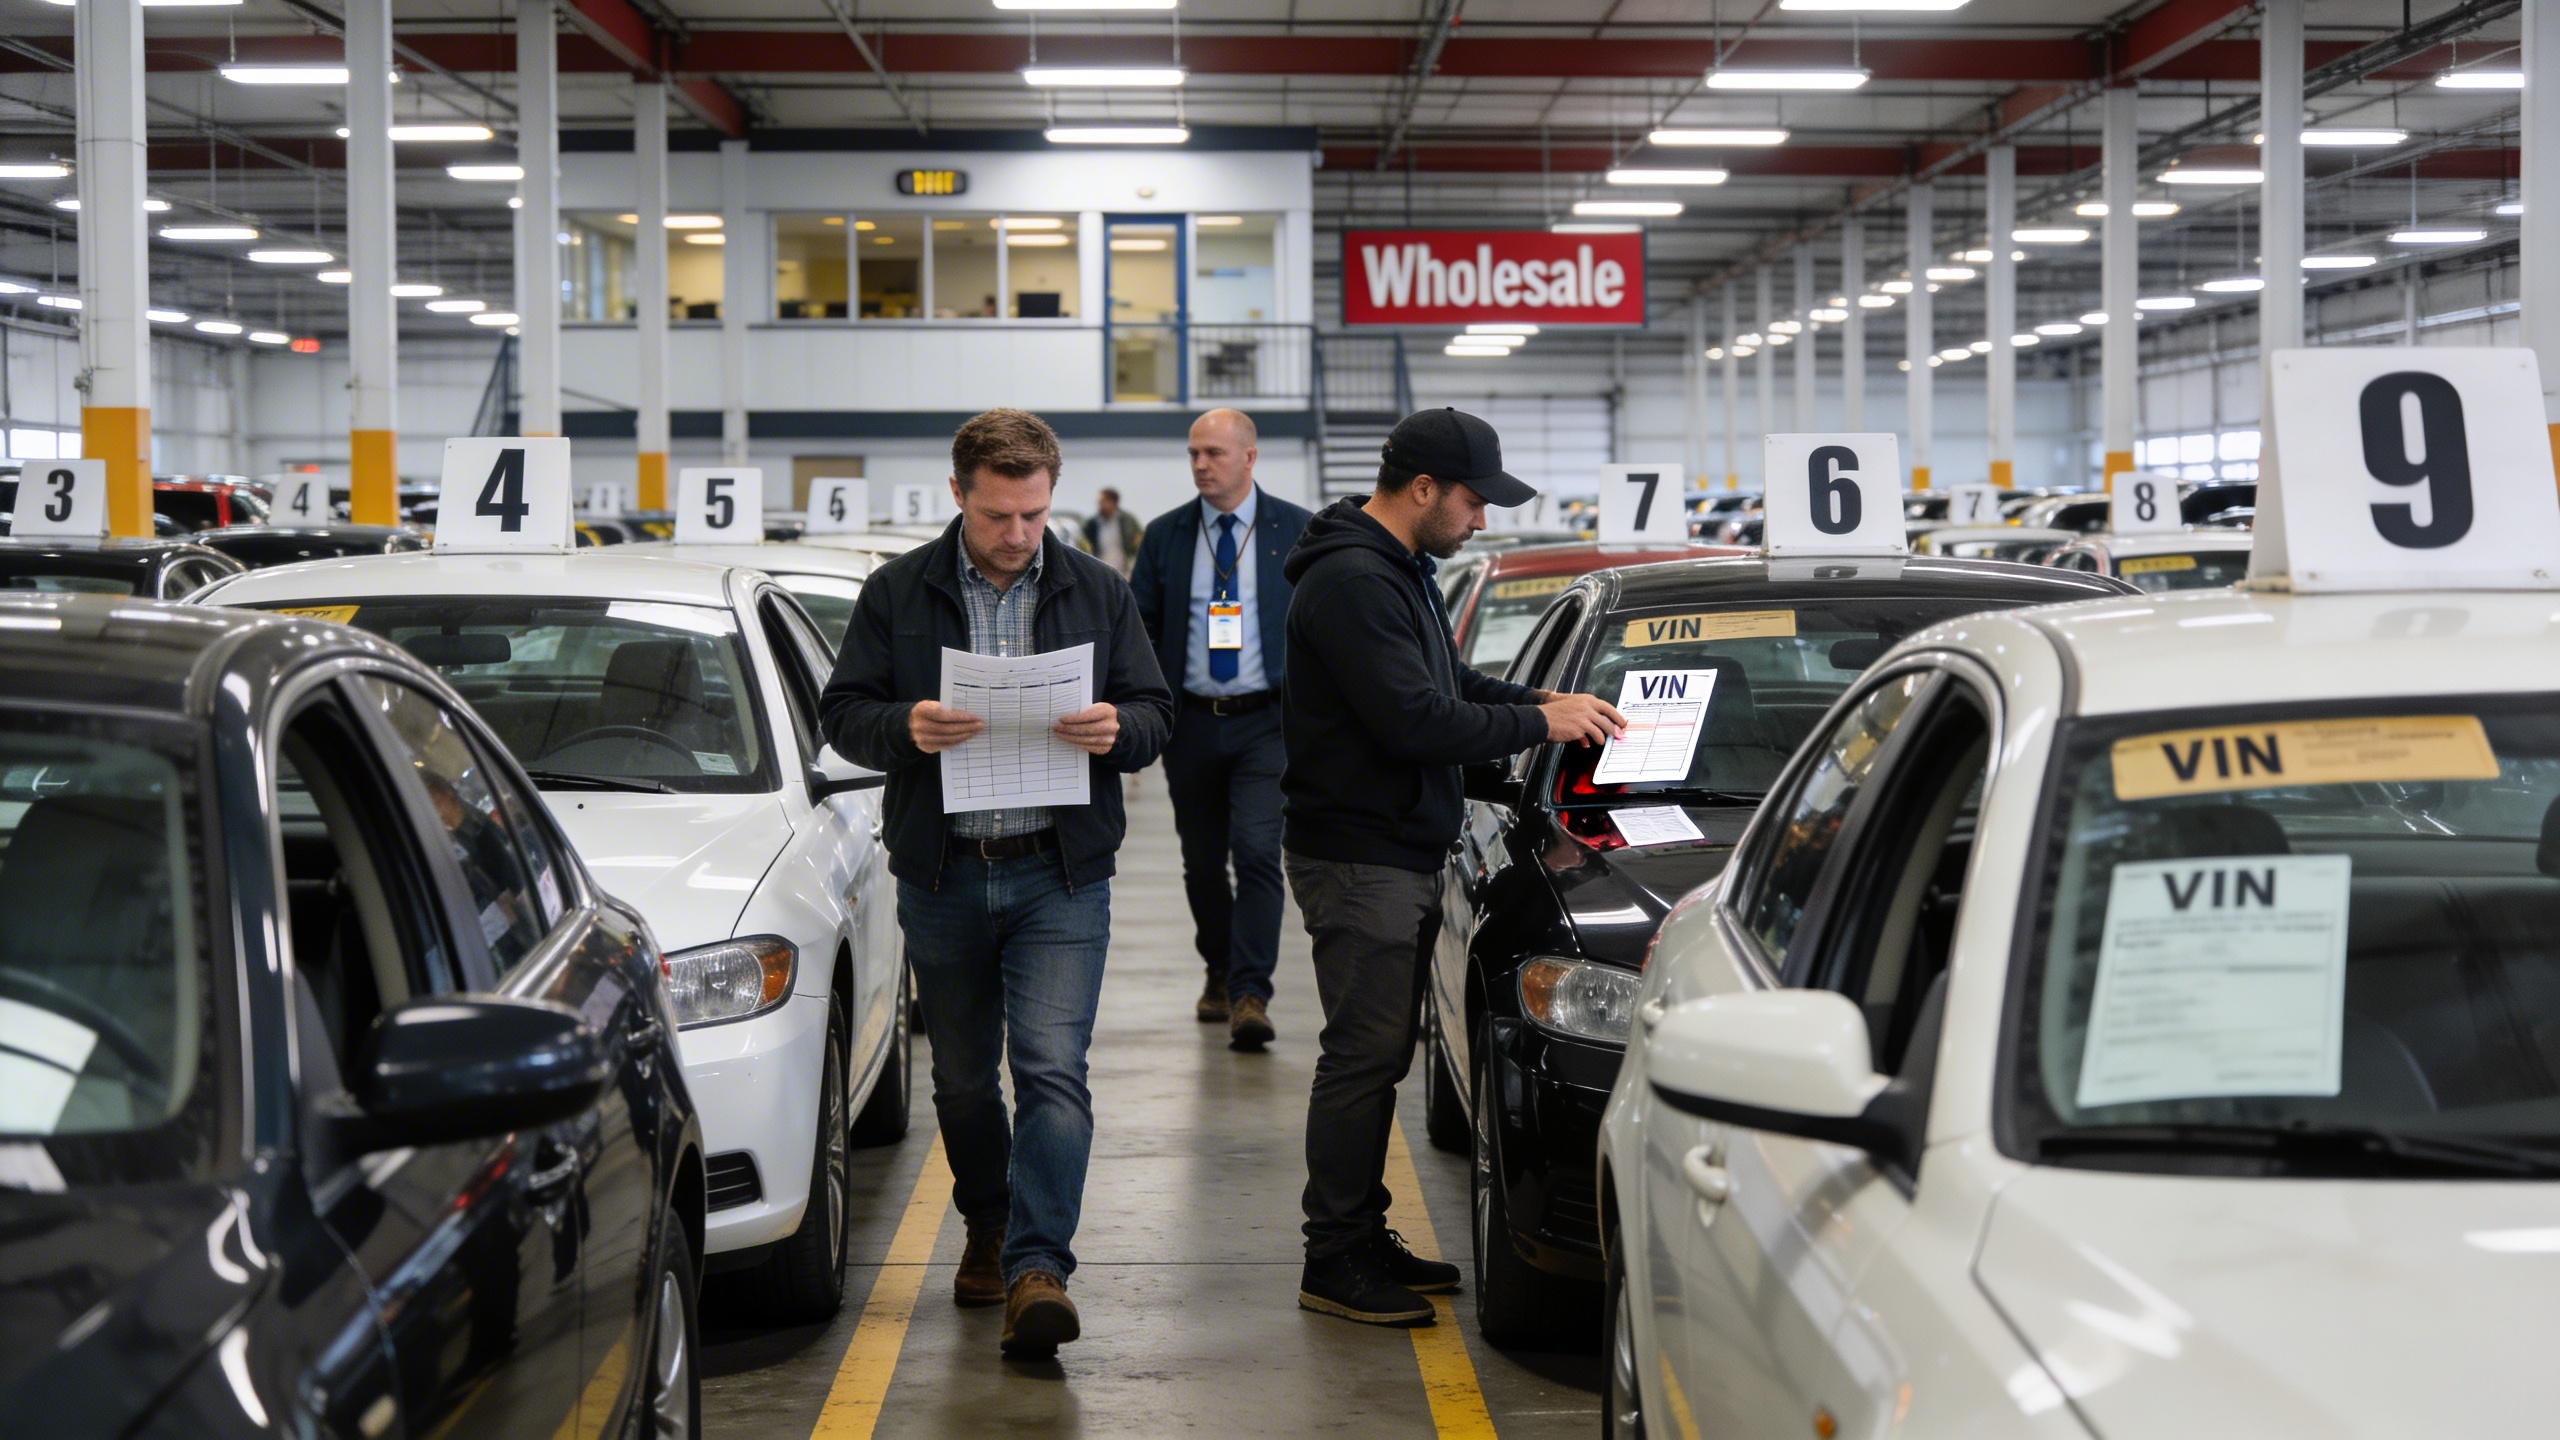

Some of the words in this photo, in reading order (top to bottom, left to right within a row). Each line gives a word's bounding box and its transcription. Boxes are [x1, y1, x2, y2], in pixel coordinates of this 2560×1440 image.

[1363, 244, 1625, 307] Wholesale
[2359, 371, 2473, 549] 9
[45, 469, 74, 522] 3
[291, 482, 309, 517] 4
[475, 448, 529, 532] 4
[705, 478, 734, 529] 5
[1626, 473, 1659, 532] 7
[1808, 446, 1862, 535] 6
[1965, 491, 1982, 519] 7
[2134, 482, 2156, 522] 8
[1647, 617, 1702, 642] VIN
[1640, 674, 1688, 700] VIN
[2161, 732, 2285, 782] VIN
[2163, 867, 2276, 911] VIN
